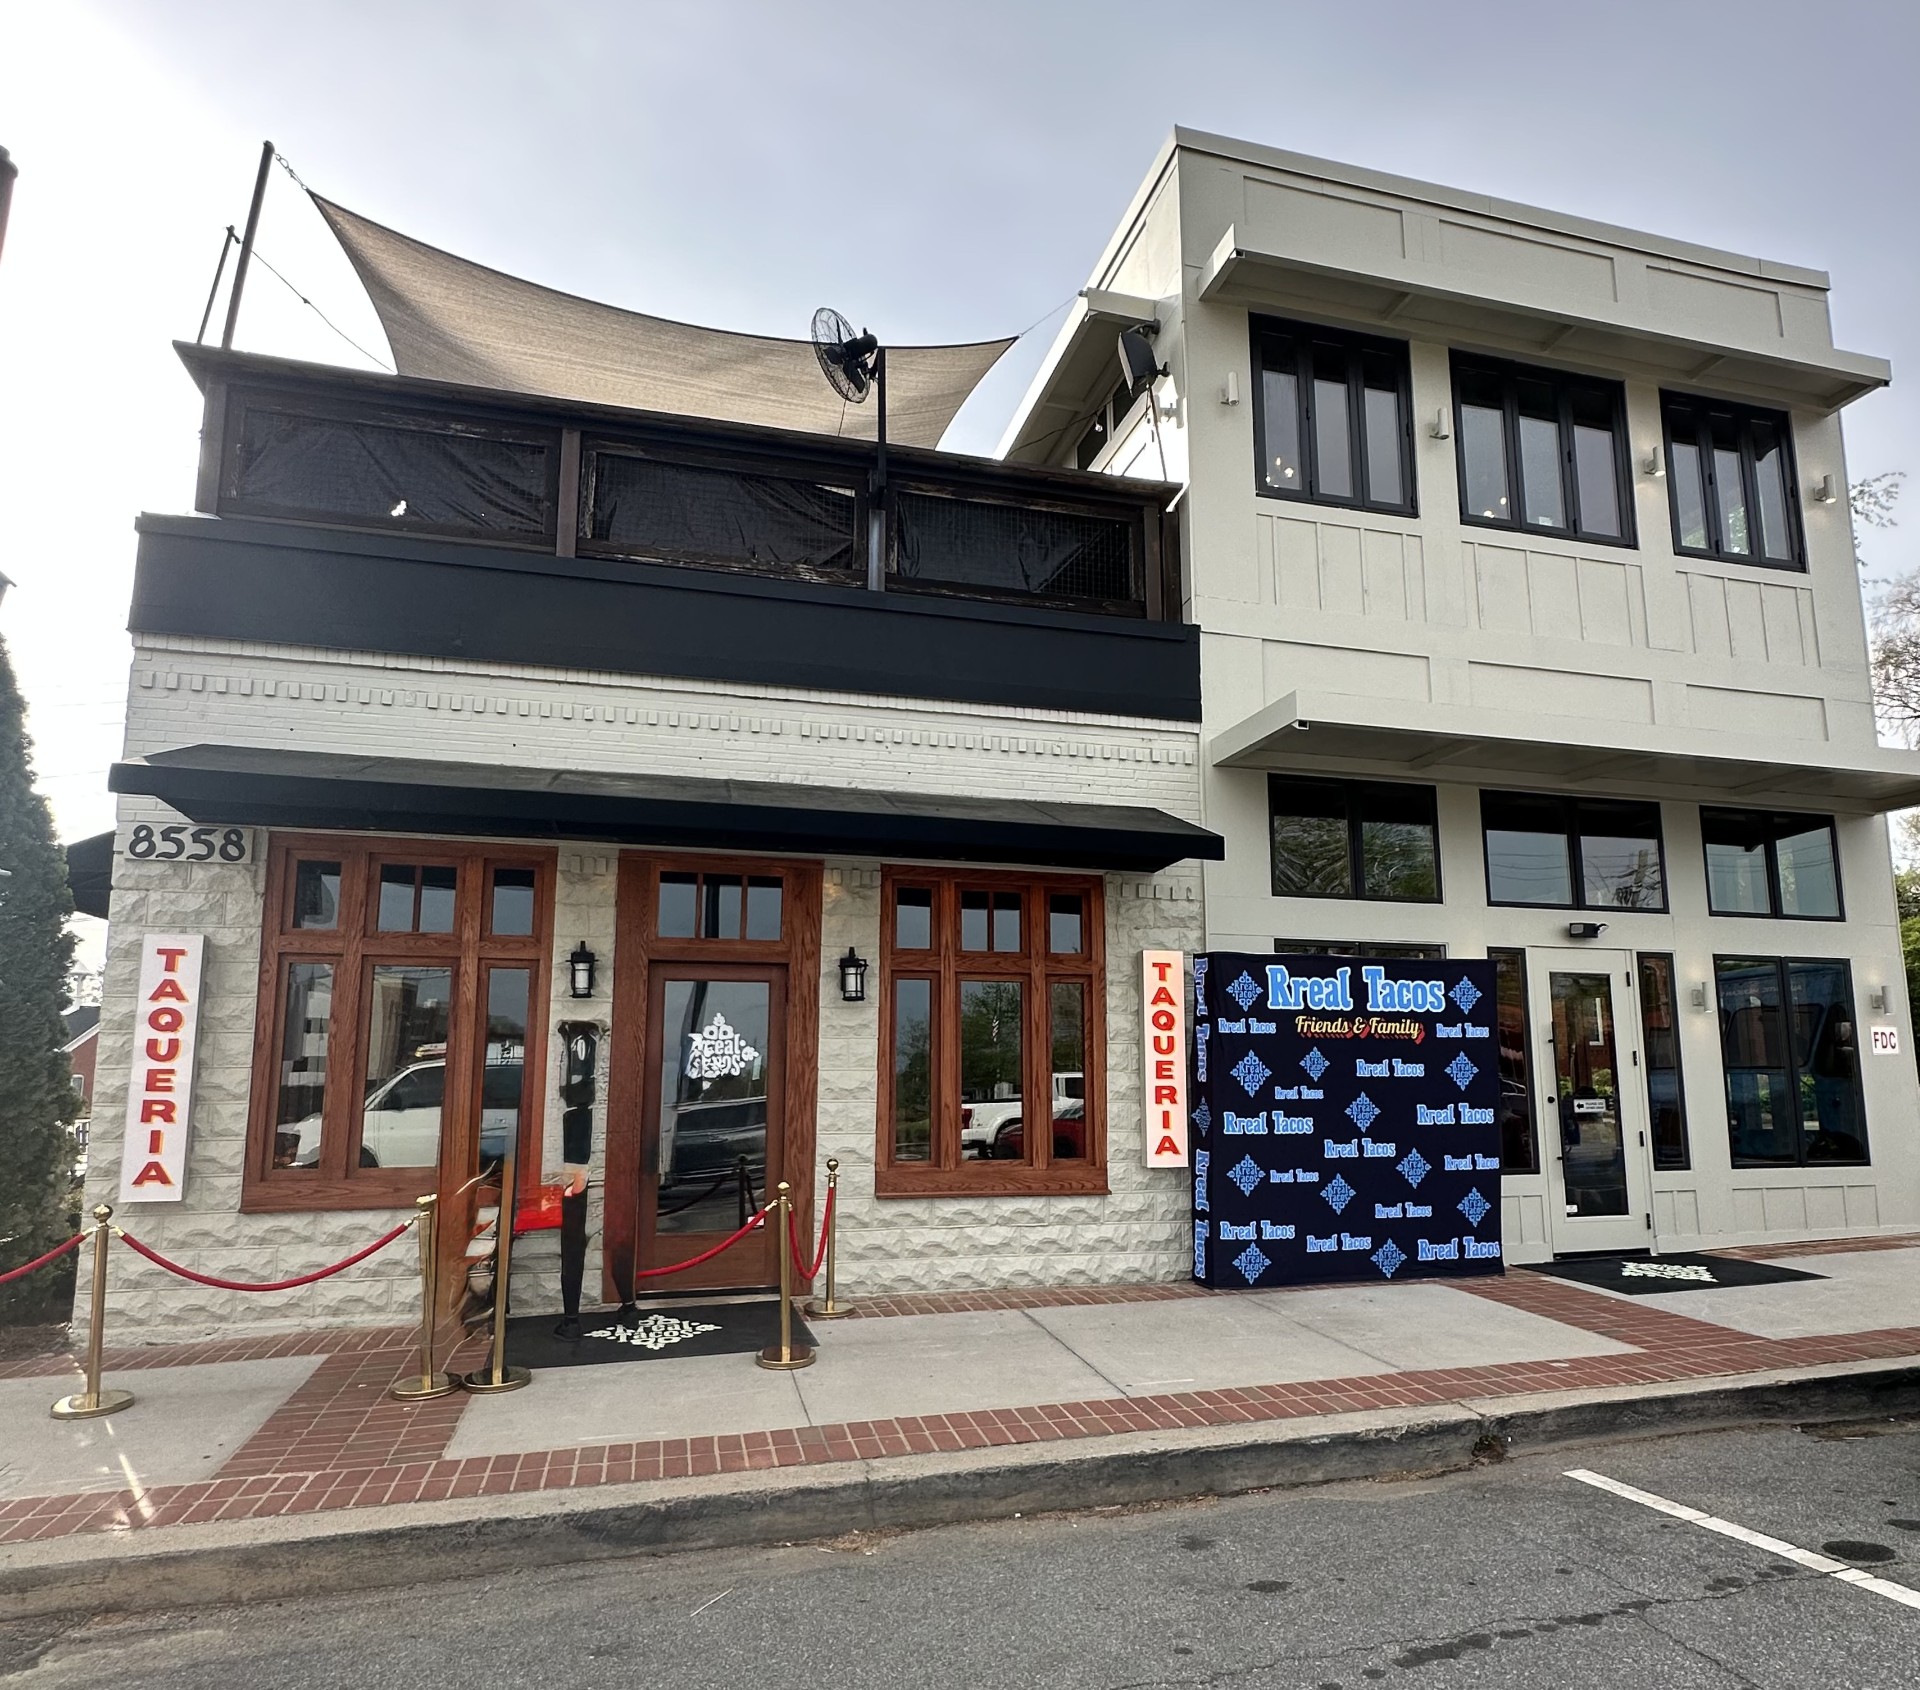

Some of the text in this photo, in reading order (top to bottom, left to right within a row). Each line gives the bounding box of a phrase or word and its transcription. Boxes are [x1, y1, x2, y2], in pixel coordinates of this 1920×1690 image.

[129, 825, 246, 862] 8558
[1266, 965, 1445, 1012] Rreal Tacos
[1218, 1018, 1277, 1034] Rreal Tacos
[1295, 1016, 1421, 1039] Friends & Family
[1436, 1022, 1489, 1038] Rreal Tacos
[1873, 1031, 1896, 1049] FDC
[132, 948, 189, 1188] TAQUERIA
[1151, 962, 1182, 1155] TAQUERIA
[1356, 1058, 1425, 1077] Rreal Tacos
[1275, 1086, 1324, 1099] Rreal Tacos
[1223, 1111, 1268, 1134] Rreal
[1272, 1110, 1314, 1134] Tacos
[1417, 1103, 1494, 1125] Rreal Tacos
[1324, 1137, 1396, 1158] Rreal Tacos
[1444, 1154, 1500, 1171] Rreal Tacos
[1270, 1168, 1319, 1183] Rreal Tacos
[1375, 1202, 1432, 1218] Rreal Tacos
[1220, 1220, 1295, 1240] Rreal Tacos
[1306, 1233, 1371, 1252] Rreal Tacos
[1418, 1236, 1500, 1261] Rreal Tacos
